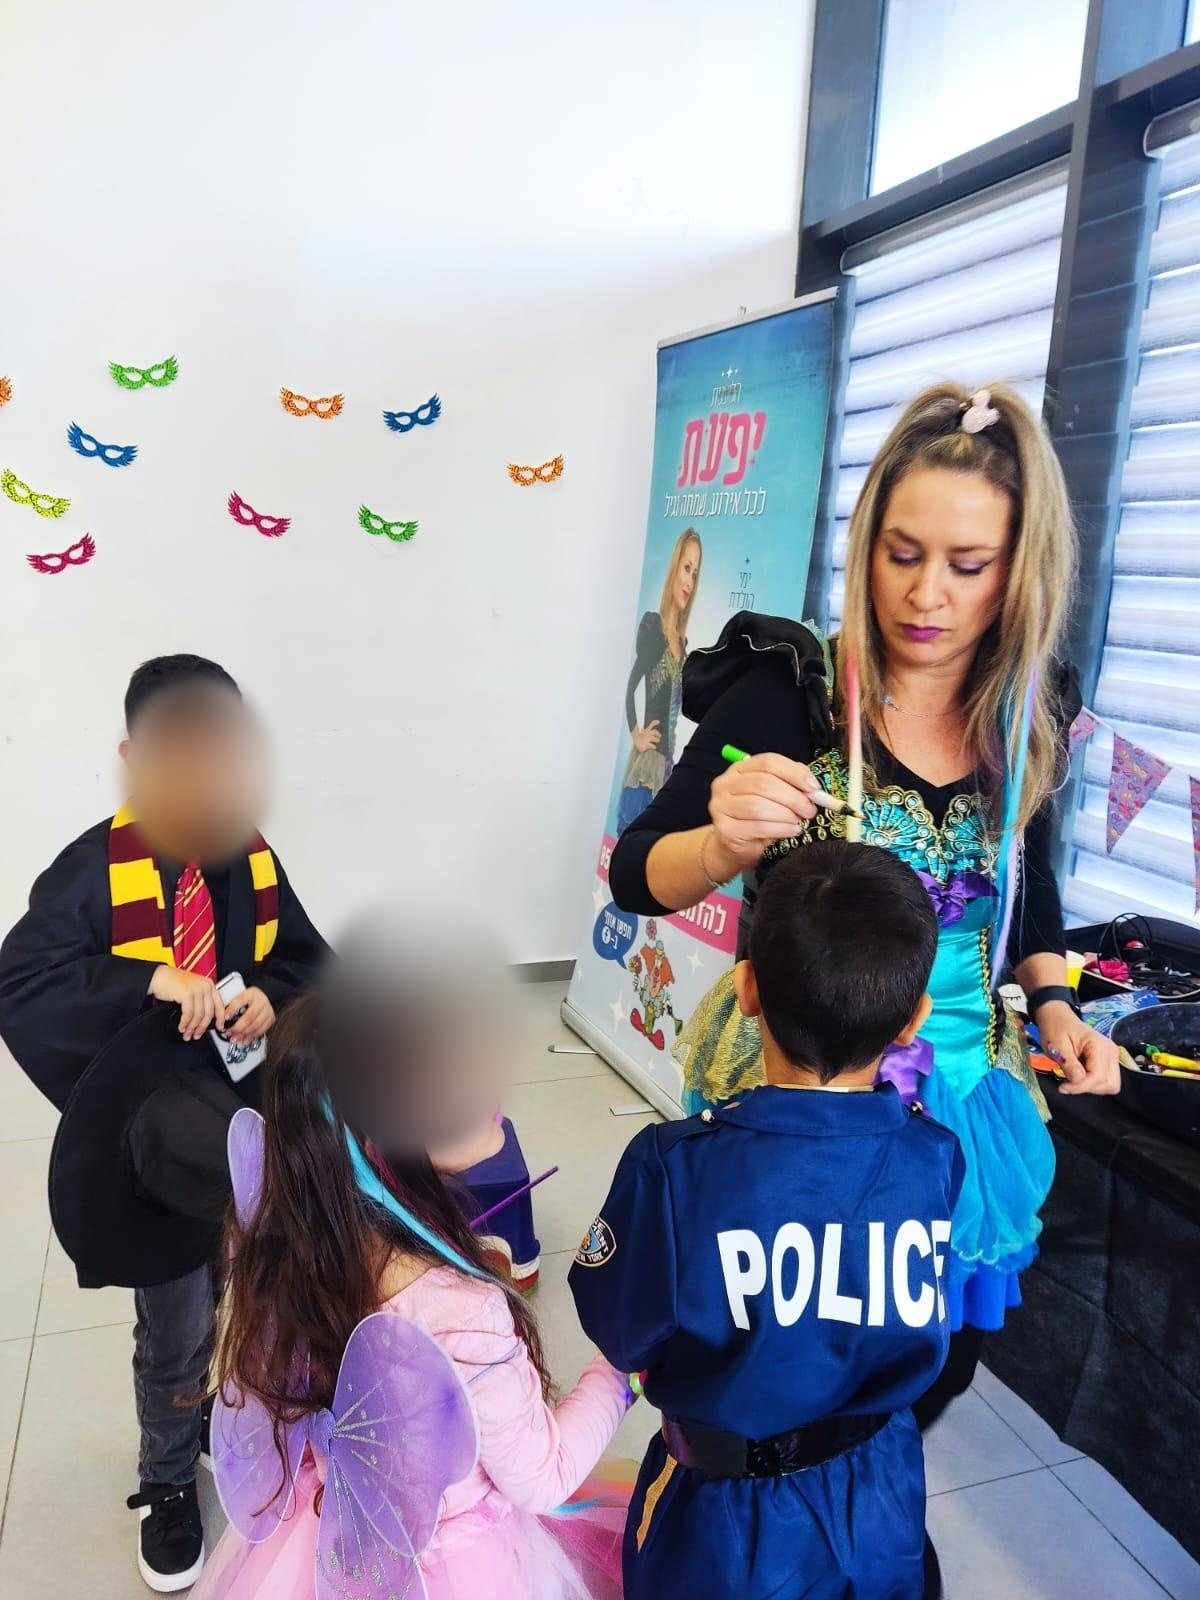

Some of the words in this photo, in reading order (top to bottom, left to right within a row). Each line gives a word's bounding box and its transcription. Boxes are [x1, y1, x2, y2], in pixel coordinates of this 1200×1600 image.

[678, 411, 767, 488] יפעת
[743, 486, 766, 516] לכל
[740, 571, 752, 589] ימי
[728, 589, 755, 610] הולדת
[604, 910, 617, 929] אותי
[616, 918, 632, 941] חפשו
[717, 1219, 952, 1331] POLICE
